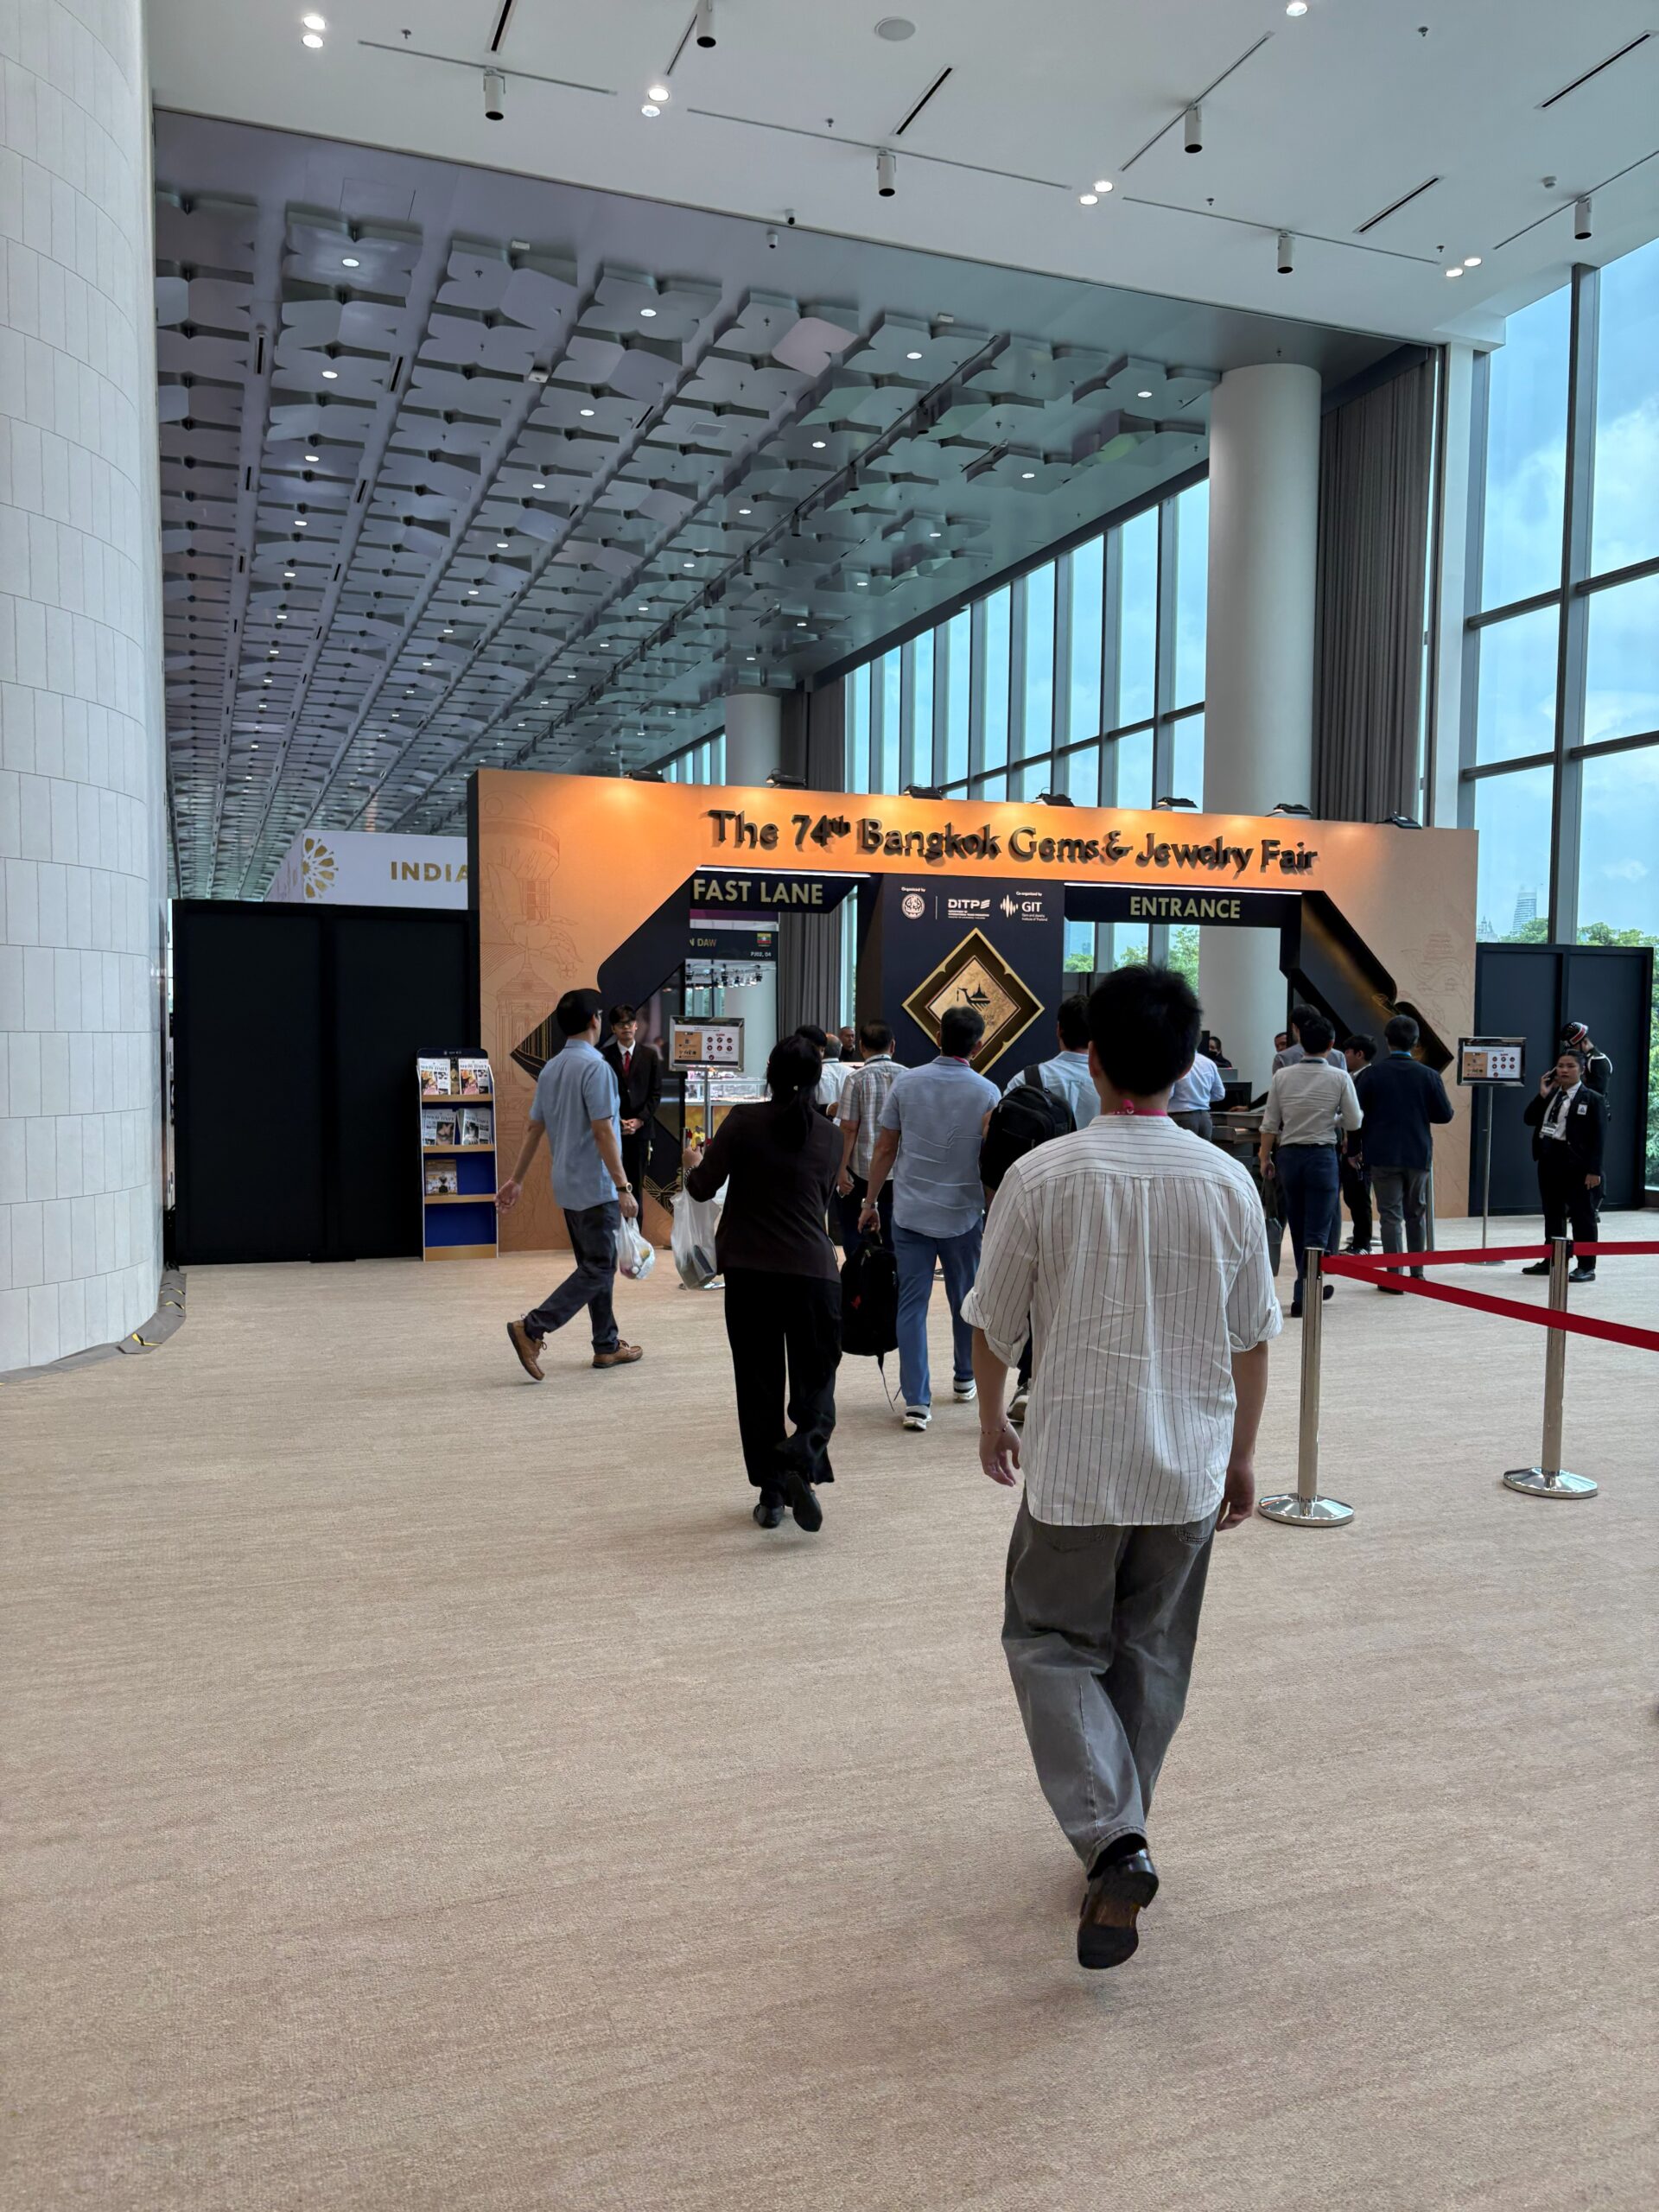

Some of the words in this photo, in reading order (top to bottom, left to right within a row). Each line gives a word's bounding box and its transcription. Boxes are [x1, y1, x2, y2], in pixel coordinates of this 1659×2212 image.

[708, 810, 779, 845] The
[791, 814, 851, 849] 74th
[859, 817, 1002, 861] Bangkok
[1008, 826, 1101, 862] Gems
[1105, 830, 1134, 860] &
[1136, 833, 1254, 874] Jewelry
[1260, 838, 1318, 872] Fair
[391, 861, 467, 882] INDIA
[693, 879, 752, 902] FAST
[760, 881, 823, 905] LANE
[948, 899, 981, 909] DITP
[1021, 901, 1043, 912] GIT
[1130, 896, 1241, 919] ENTRANCE
[697, 938, 717, 947] DAW
